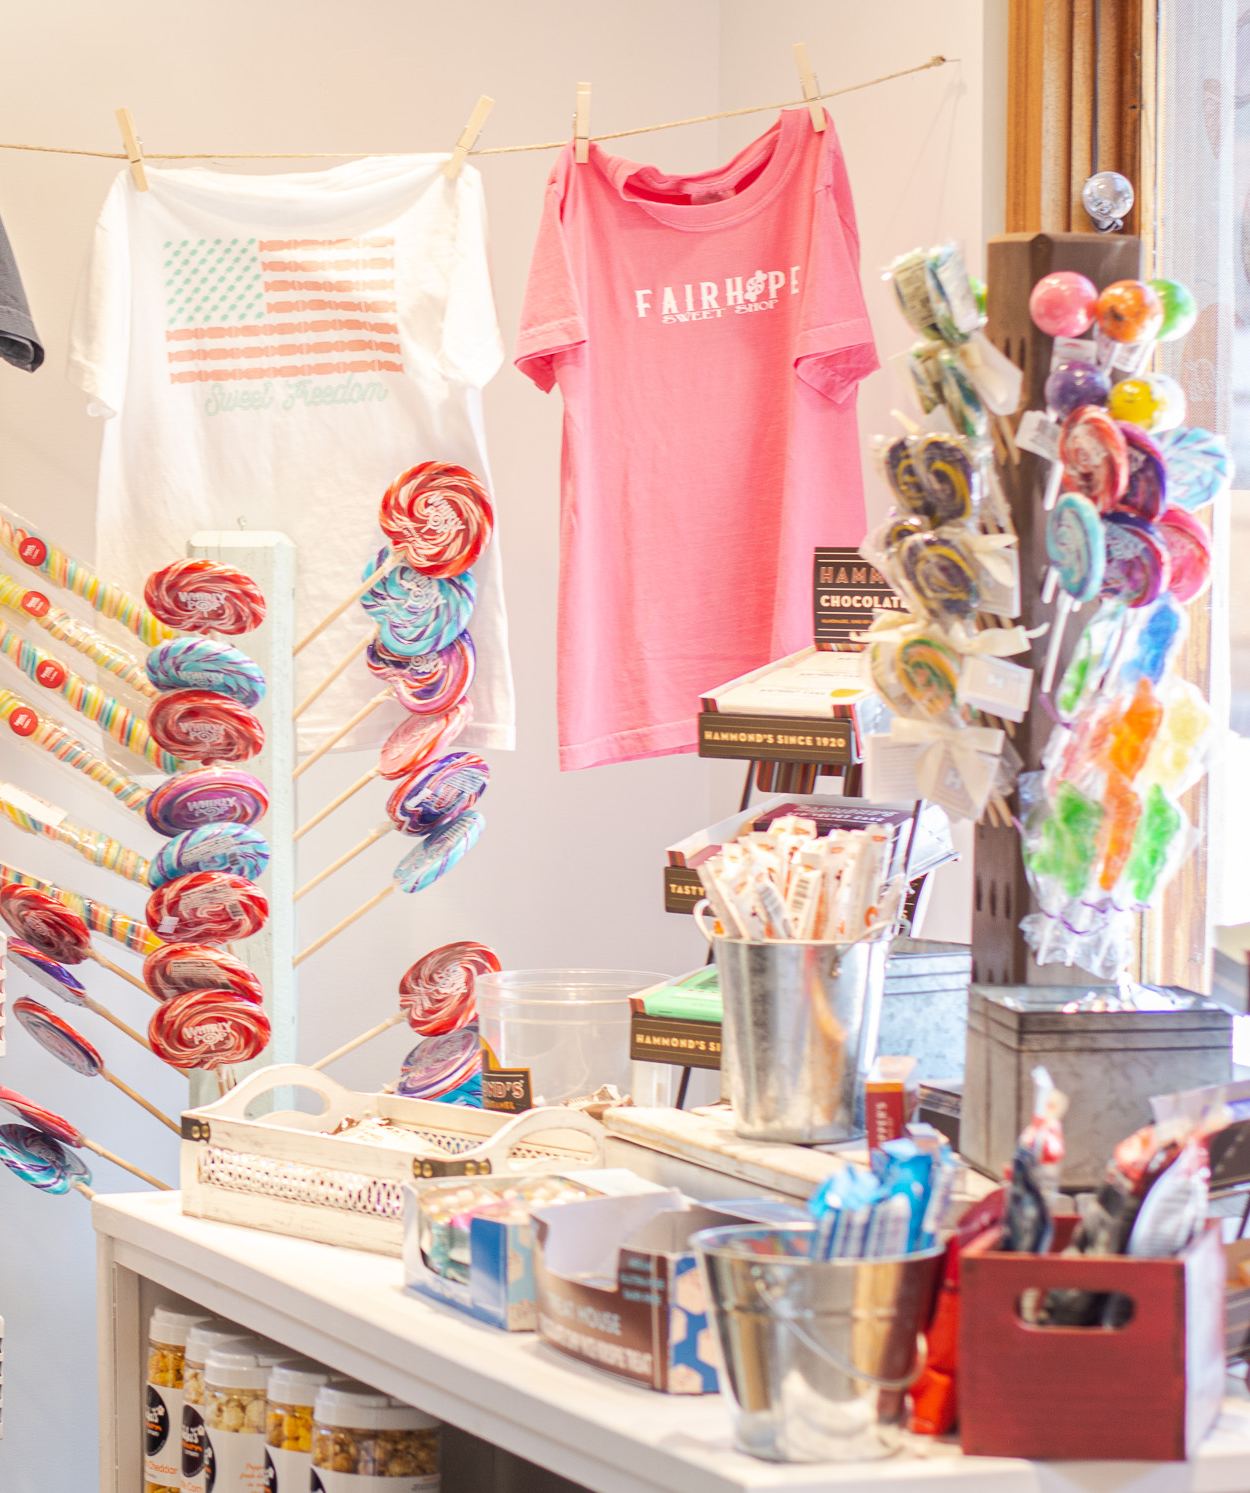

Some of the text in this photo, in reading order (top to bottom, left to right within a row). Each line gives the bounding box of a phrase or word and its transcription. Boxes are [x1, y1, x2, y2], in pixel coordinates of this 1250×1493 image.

[661, 298, 780, 325] SWEET SHOP
[204, 371, 389, 417] Sweet Freedom
[704, 730, 846, 748] HAMMOND'S SINCE 1920
[636, 1034, 706, 1052] HAMMOND'S
